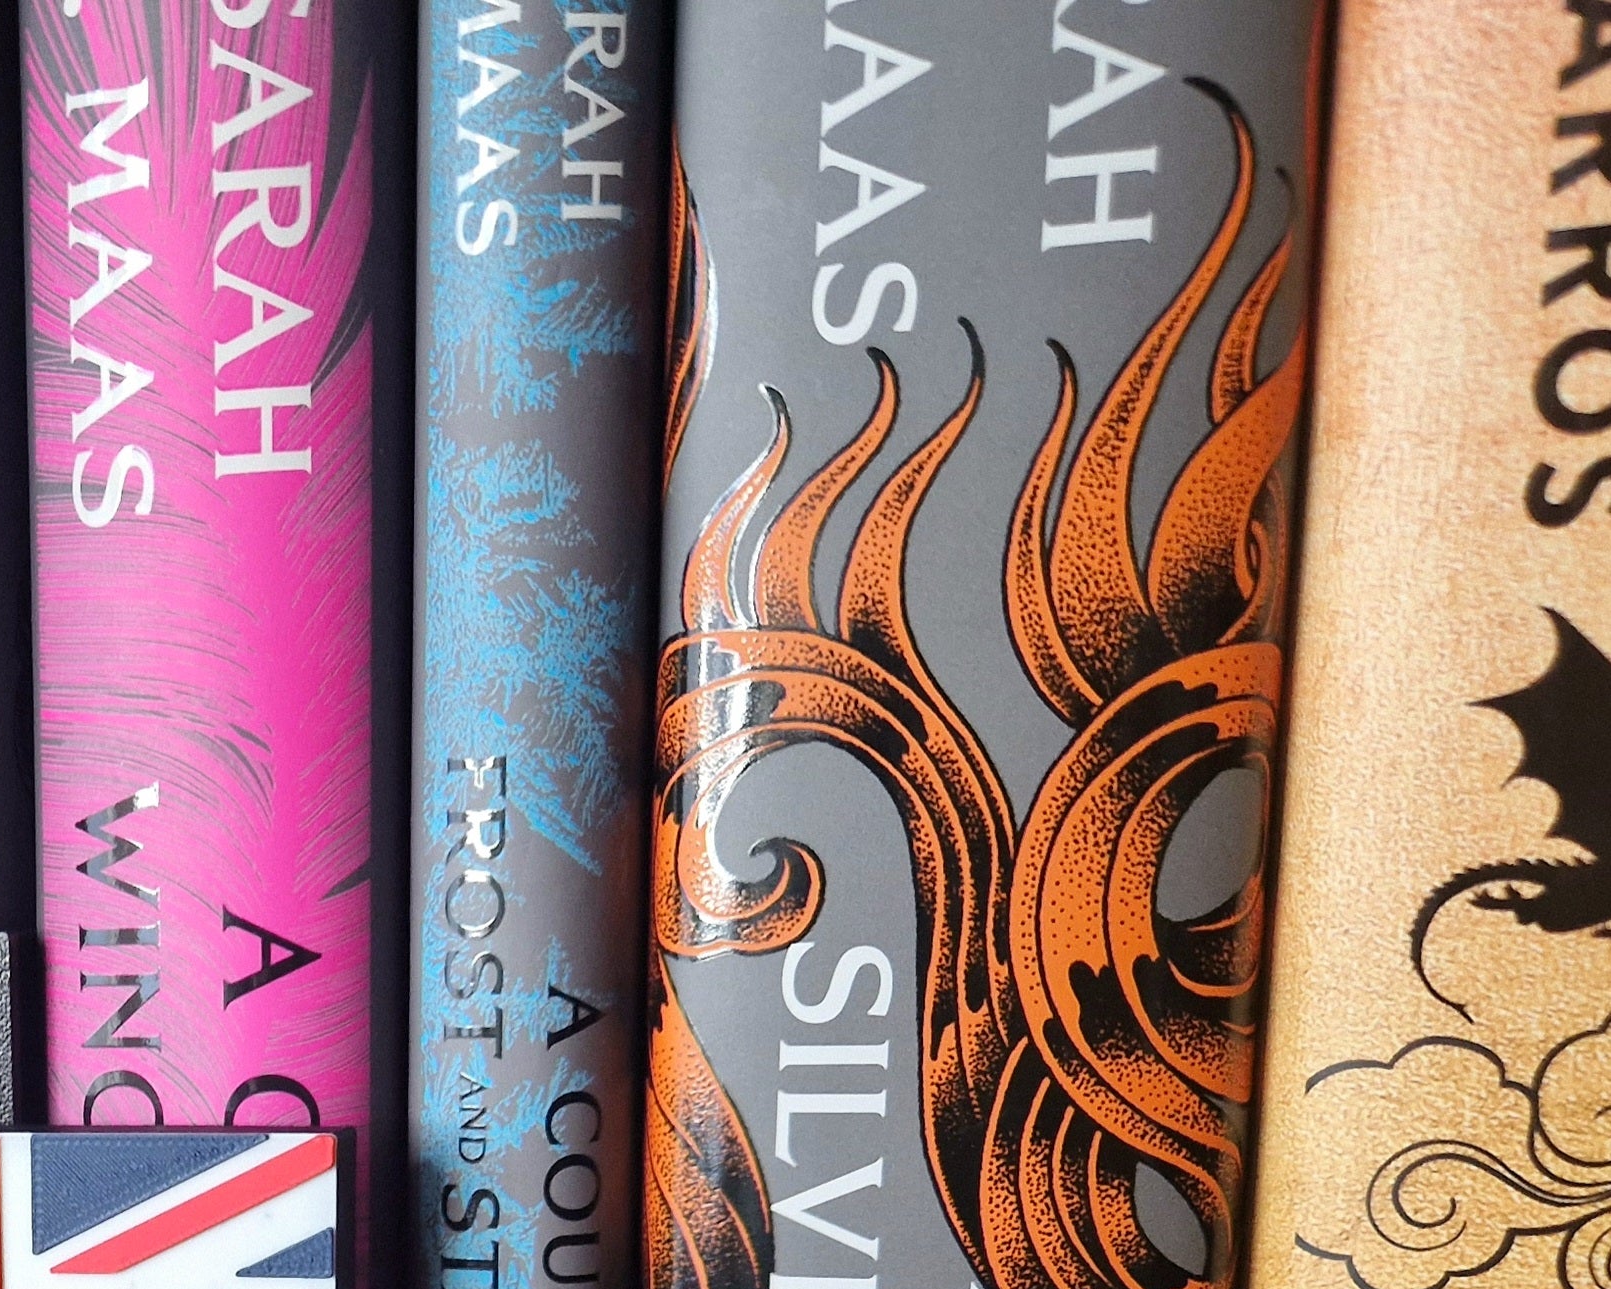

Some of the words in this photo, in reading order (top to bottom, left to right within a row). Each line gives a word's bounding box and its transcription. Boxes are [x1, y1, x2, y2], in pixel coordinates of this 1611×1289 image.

[810, 0, 935, 346] AAS
[1041, 0, 1169, 253] AH
[64, 75, 155, 529] MAAS
[222, 904, 324, 1011] A
[443, 756, 506, 1060] FROST
[547, 983, 608, 1054] A
[459, 1072, 488, 1164] AND
